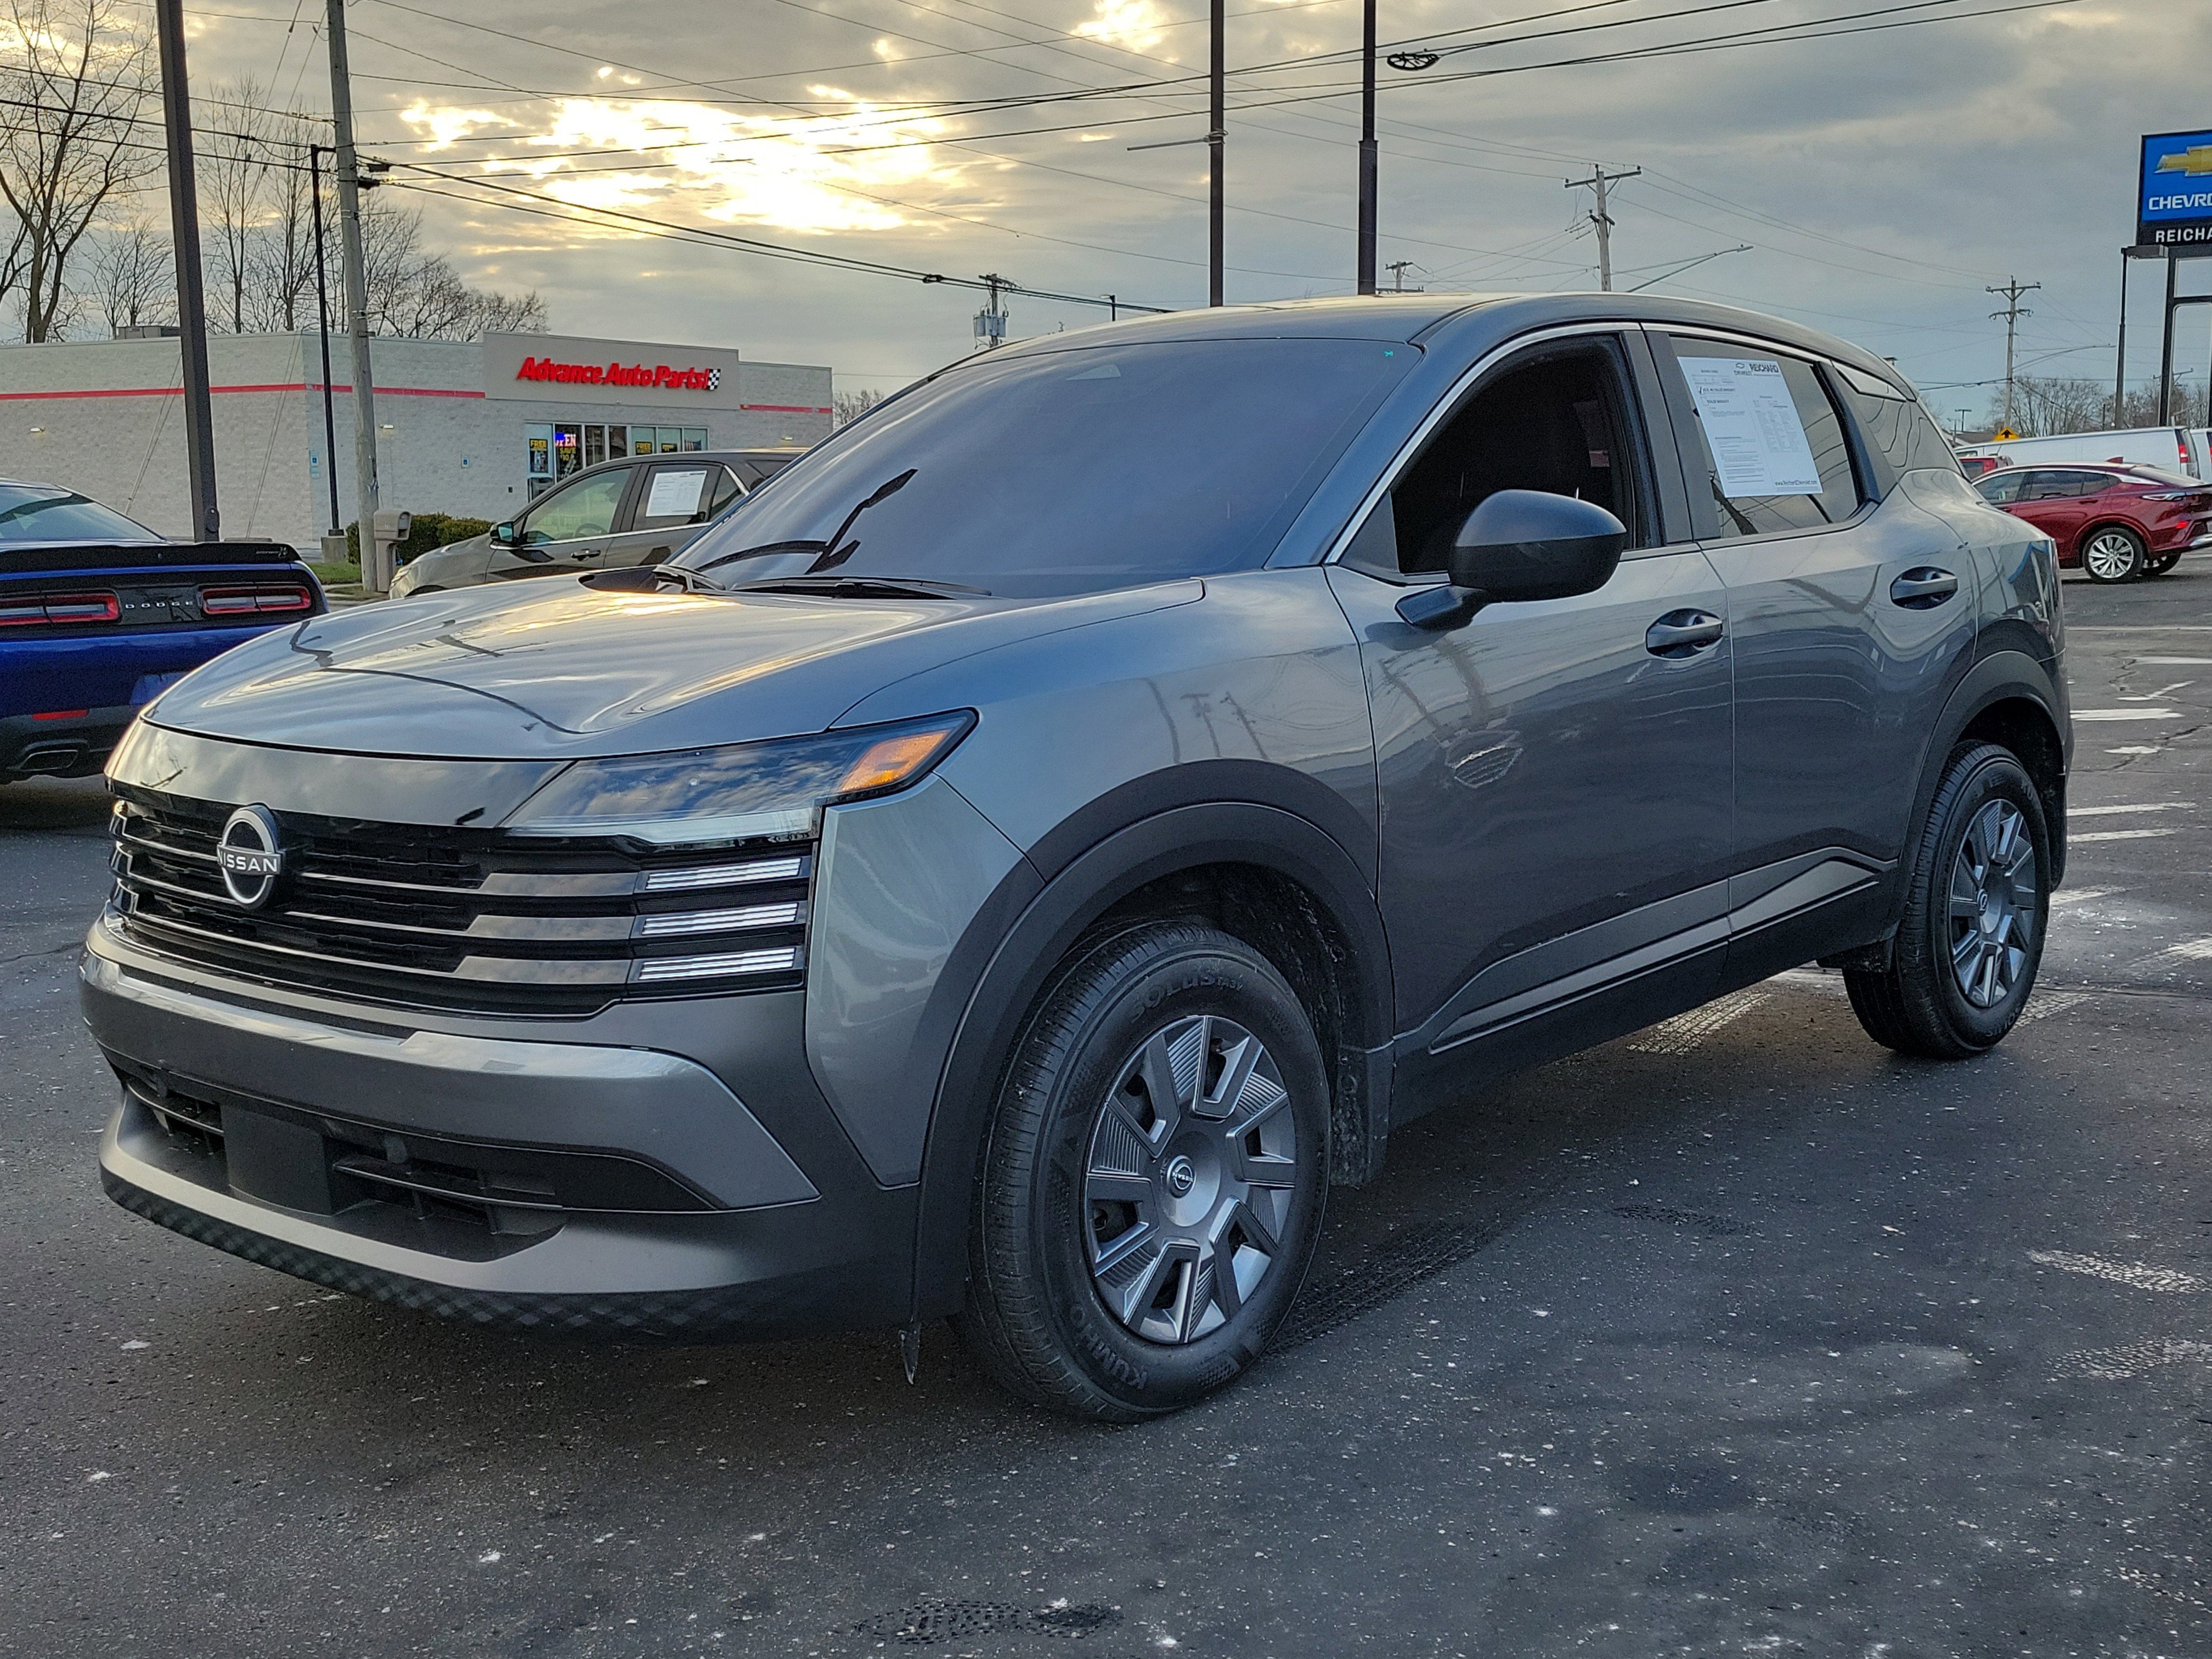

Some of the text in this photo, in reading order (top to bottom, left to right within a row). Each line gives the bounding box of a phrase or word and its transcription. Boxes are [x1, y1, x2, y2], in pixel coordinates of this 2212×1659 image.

[516, 357, 602, 383] Advance
[603, 363, 653, 386] Auto
[218, 850, 278, 872] NISSAN
